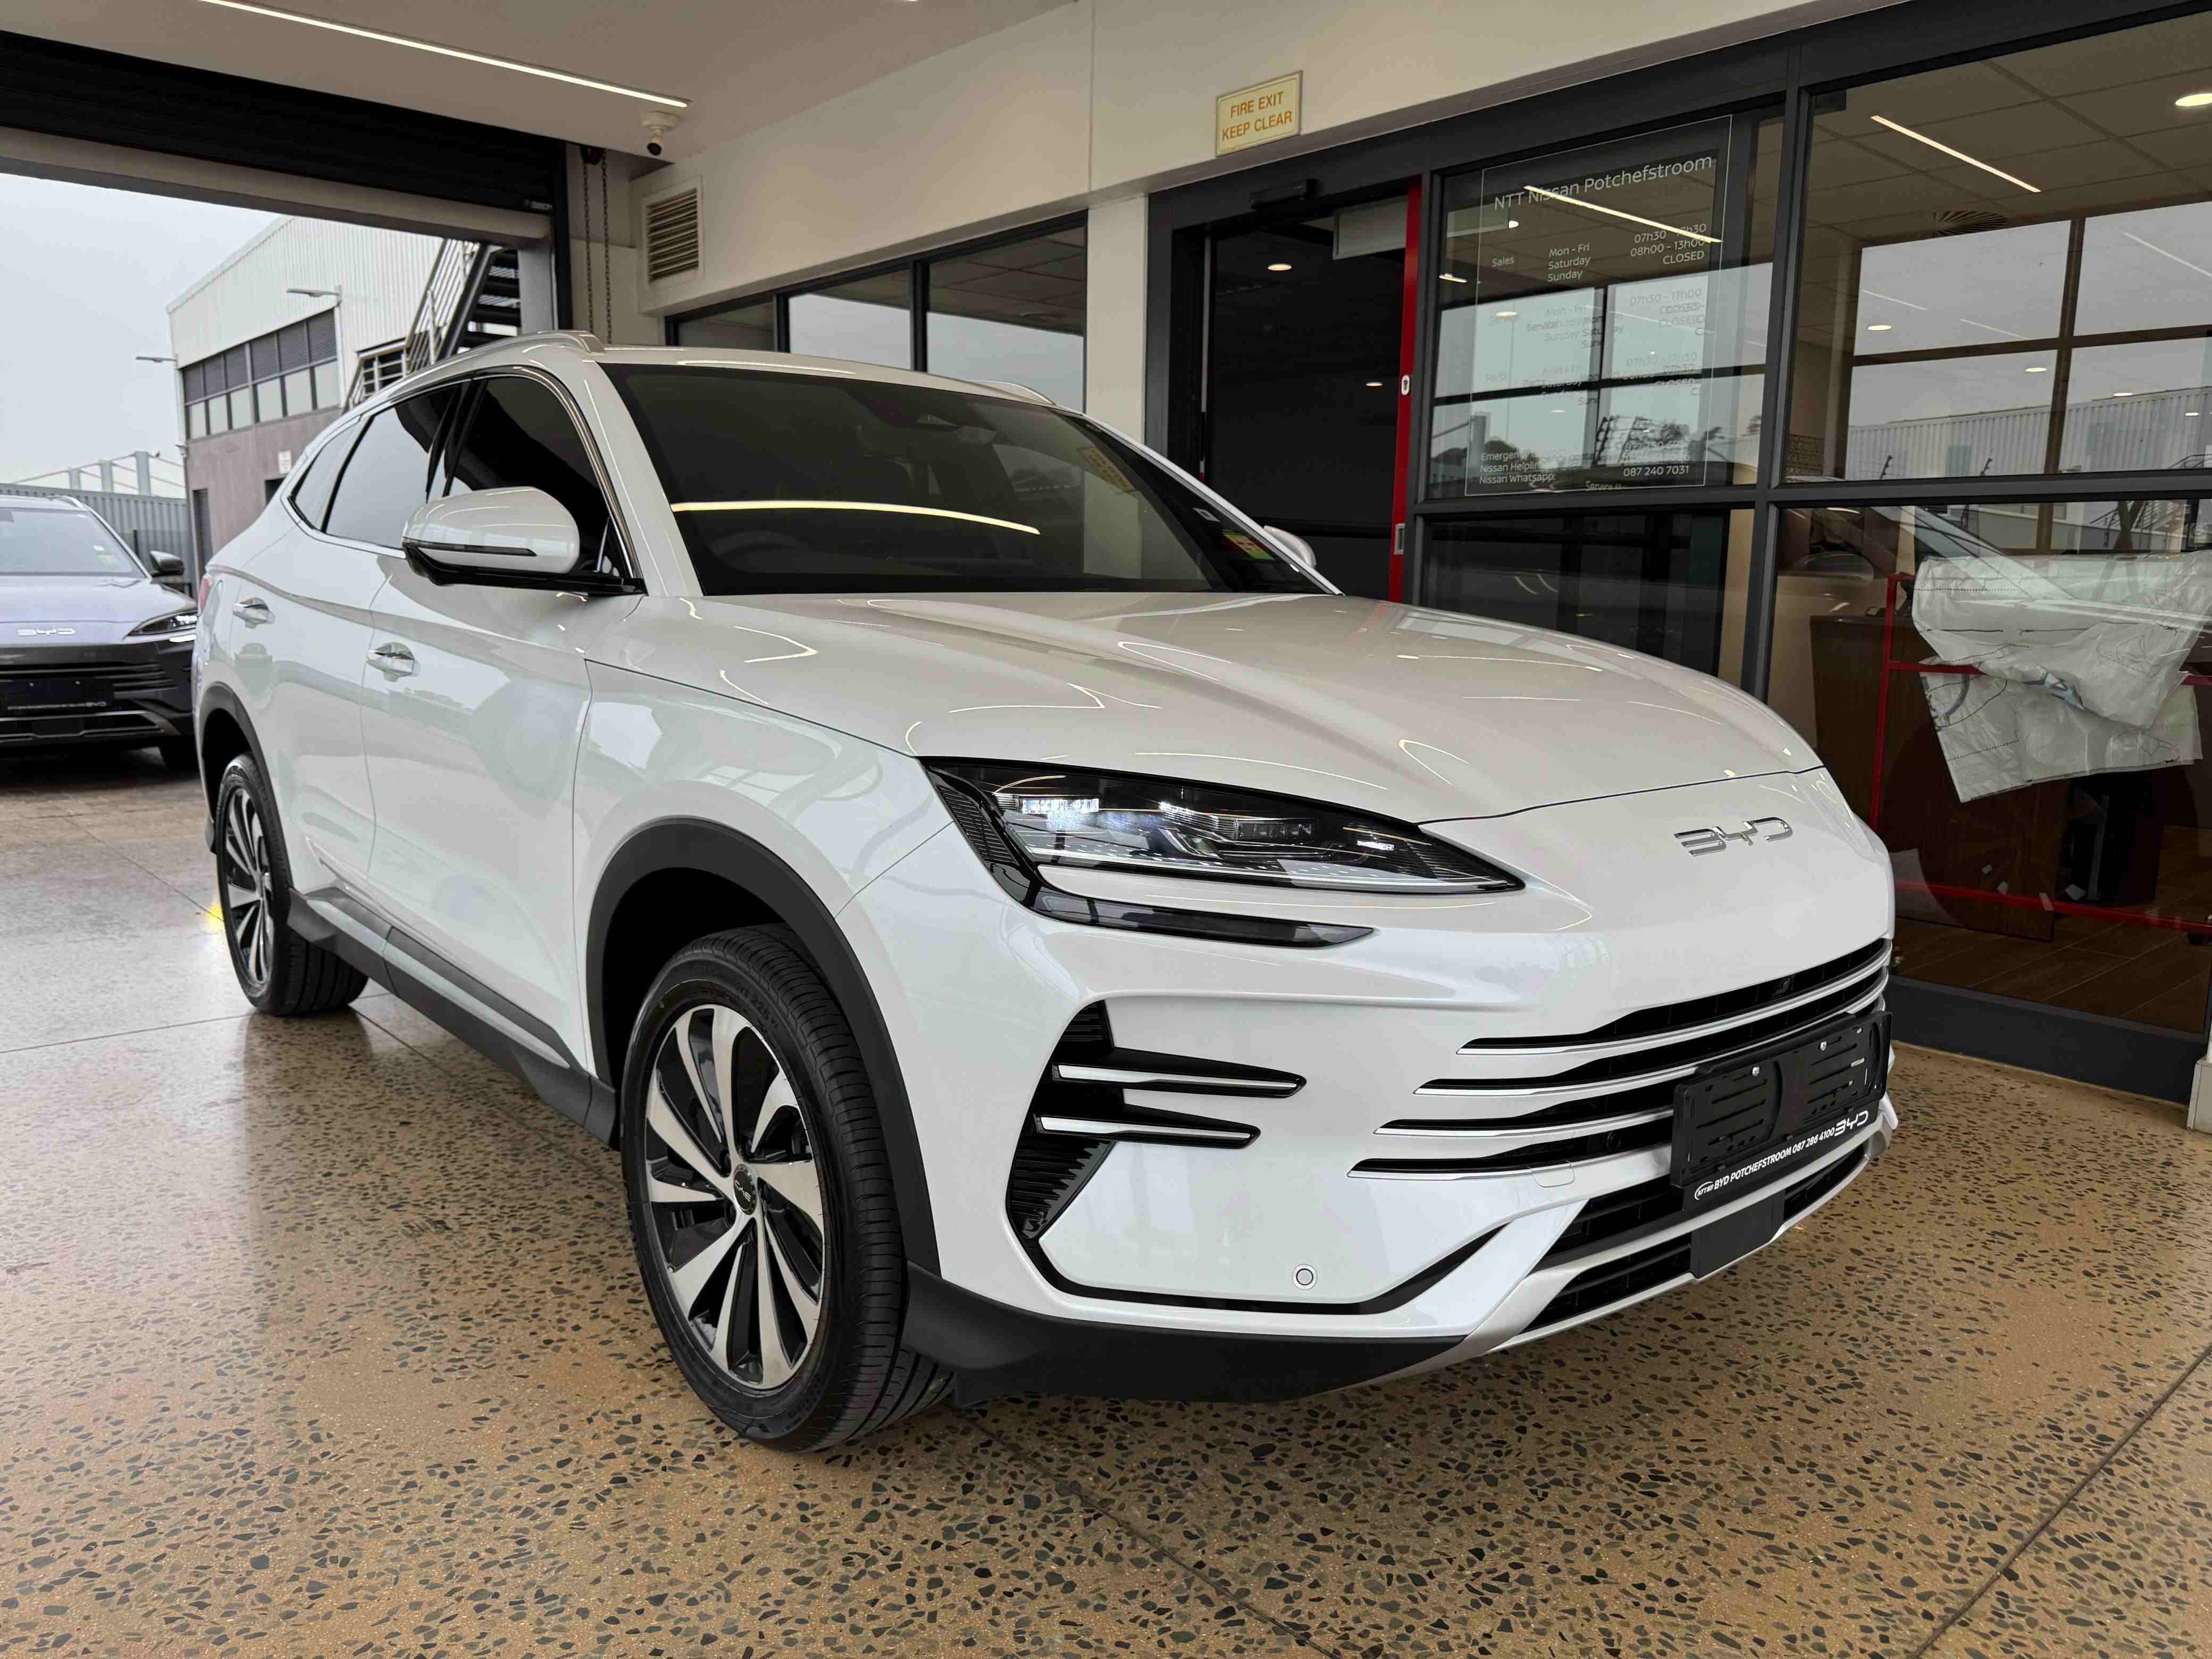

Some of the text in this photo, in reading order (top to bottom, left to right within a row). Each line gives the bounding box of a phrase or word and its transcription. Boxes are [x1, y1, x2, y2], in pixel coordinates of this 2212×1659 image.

[1230, 91, 1284, 119] FIRE EXIT
[1222, 110, 1292, 140] KEEP CLEAR
[1495, 156, 1712, 210] NTT Nissan Potchefstroom
[1634, 223, 1706, 243] 07h30 7h30
[1549, 248, 1569, 257] Mon
[1578, 242, 1590, 253] Fri
[1630, 244, 1664, 256] 08h00
[1674, 237, 1705, 250] 13h00
[1492, 256, 1515, 267] Sales
[1548, 256, 1591, 270] Saturday
[1663, 250, 1704, 264] CLOSED
[1548, 270, 1583, 282] Sunday
[1480, 460, 1540, 473] Nissan Helplin
[1623, 465, 1689, 476] 087 240 7031
[1479, 475, 1507, 484] Nissan
[1674, 817, 1793, 857] BYD
[1714, 1175, 1730, 1190] BYD
[1730, 1146, 1792, 1183] POTCHEFSTROOM
[1792, 1140, 1806, 1154] 087
[1805, 1134, 1819, 1148] 286
[1819, 1127, 1835, 1141] 4100
[1834, 1110, 1869, 1136] BYD
